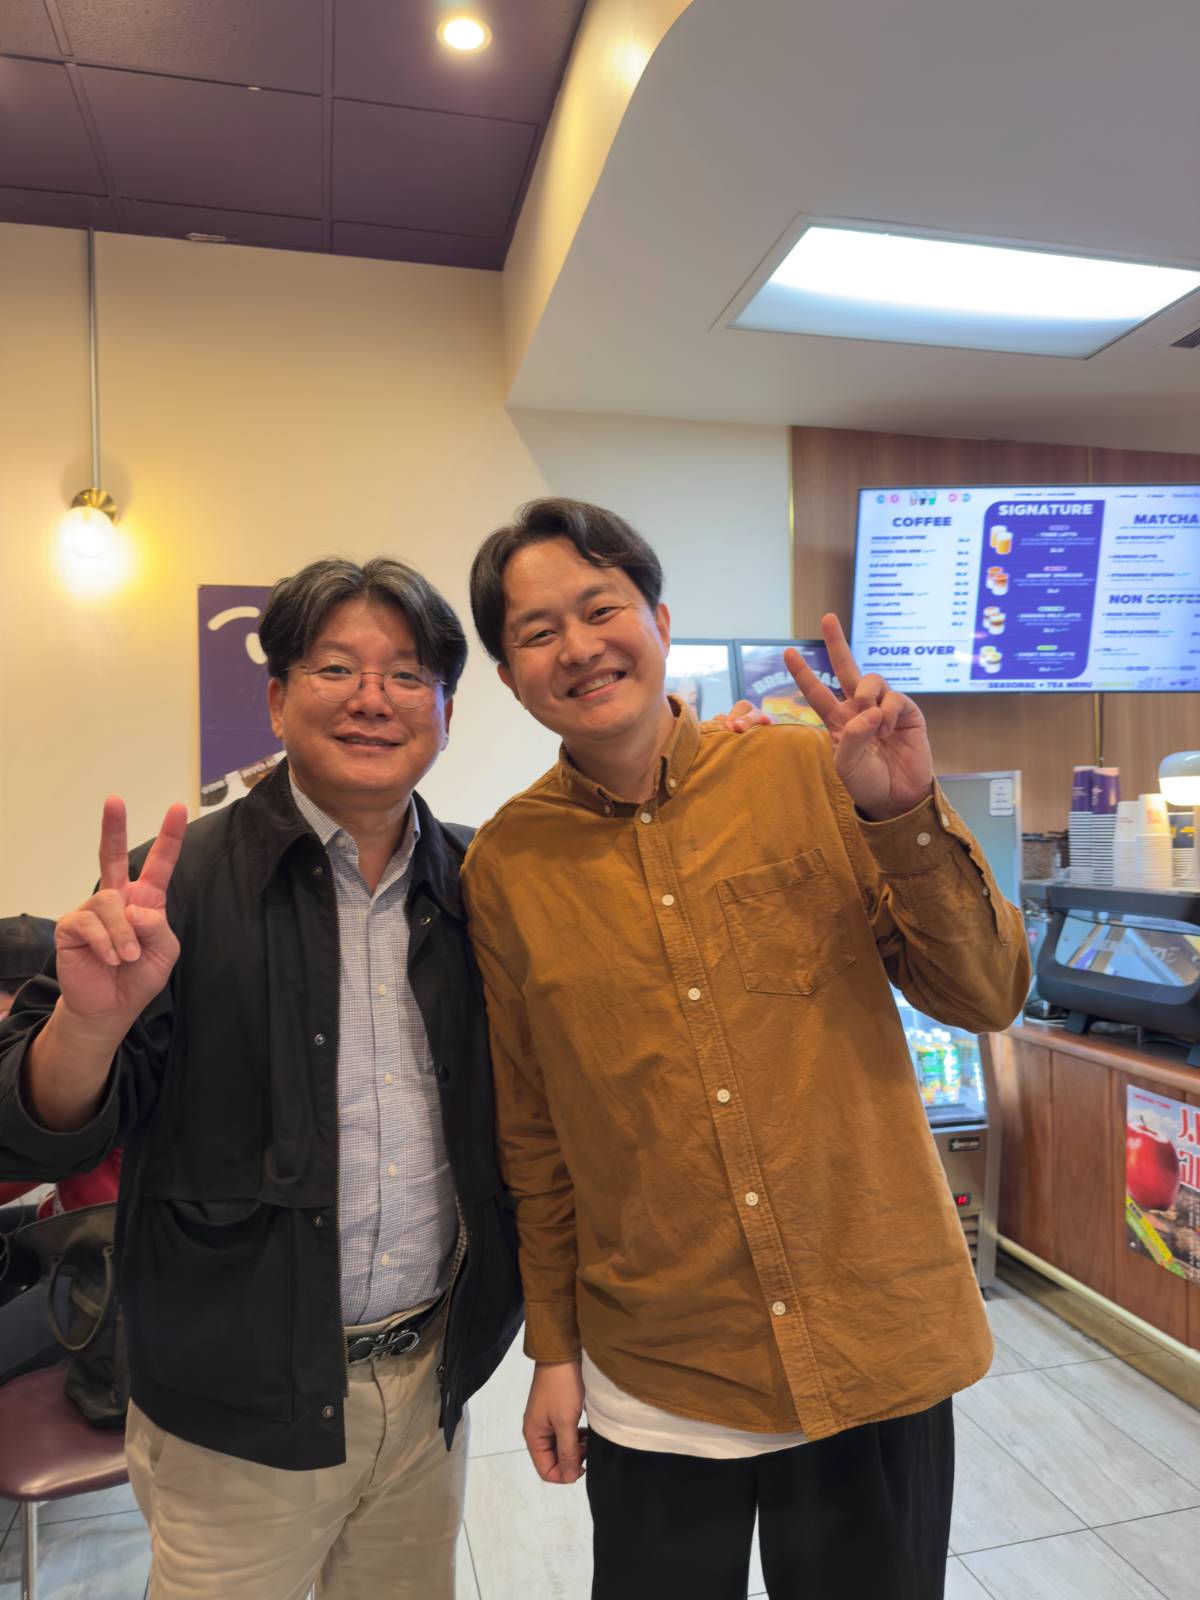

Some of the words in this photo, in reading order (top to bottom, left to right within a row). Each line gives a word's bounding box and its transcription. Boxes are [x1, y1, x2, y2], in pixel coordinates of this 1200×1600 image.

[998, 503, 1094, 516] SIGNATURE
[892, 516, 952, 528] COFFEE
[1133, 513, 1199, 525] MATCHA
[1109, 594, 1142, 604] NON
[868, 646, 911, 656] POUR
[914, 645, 955, 656] OVER
